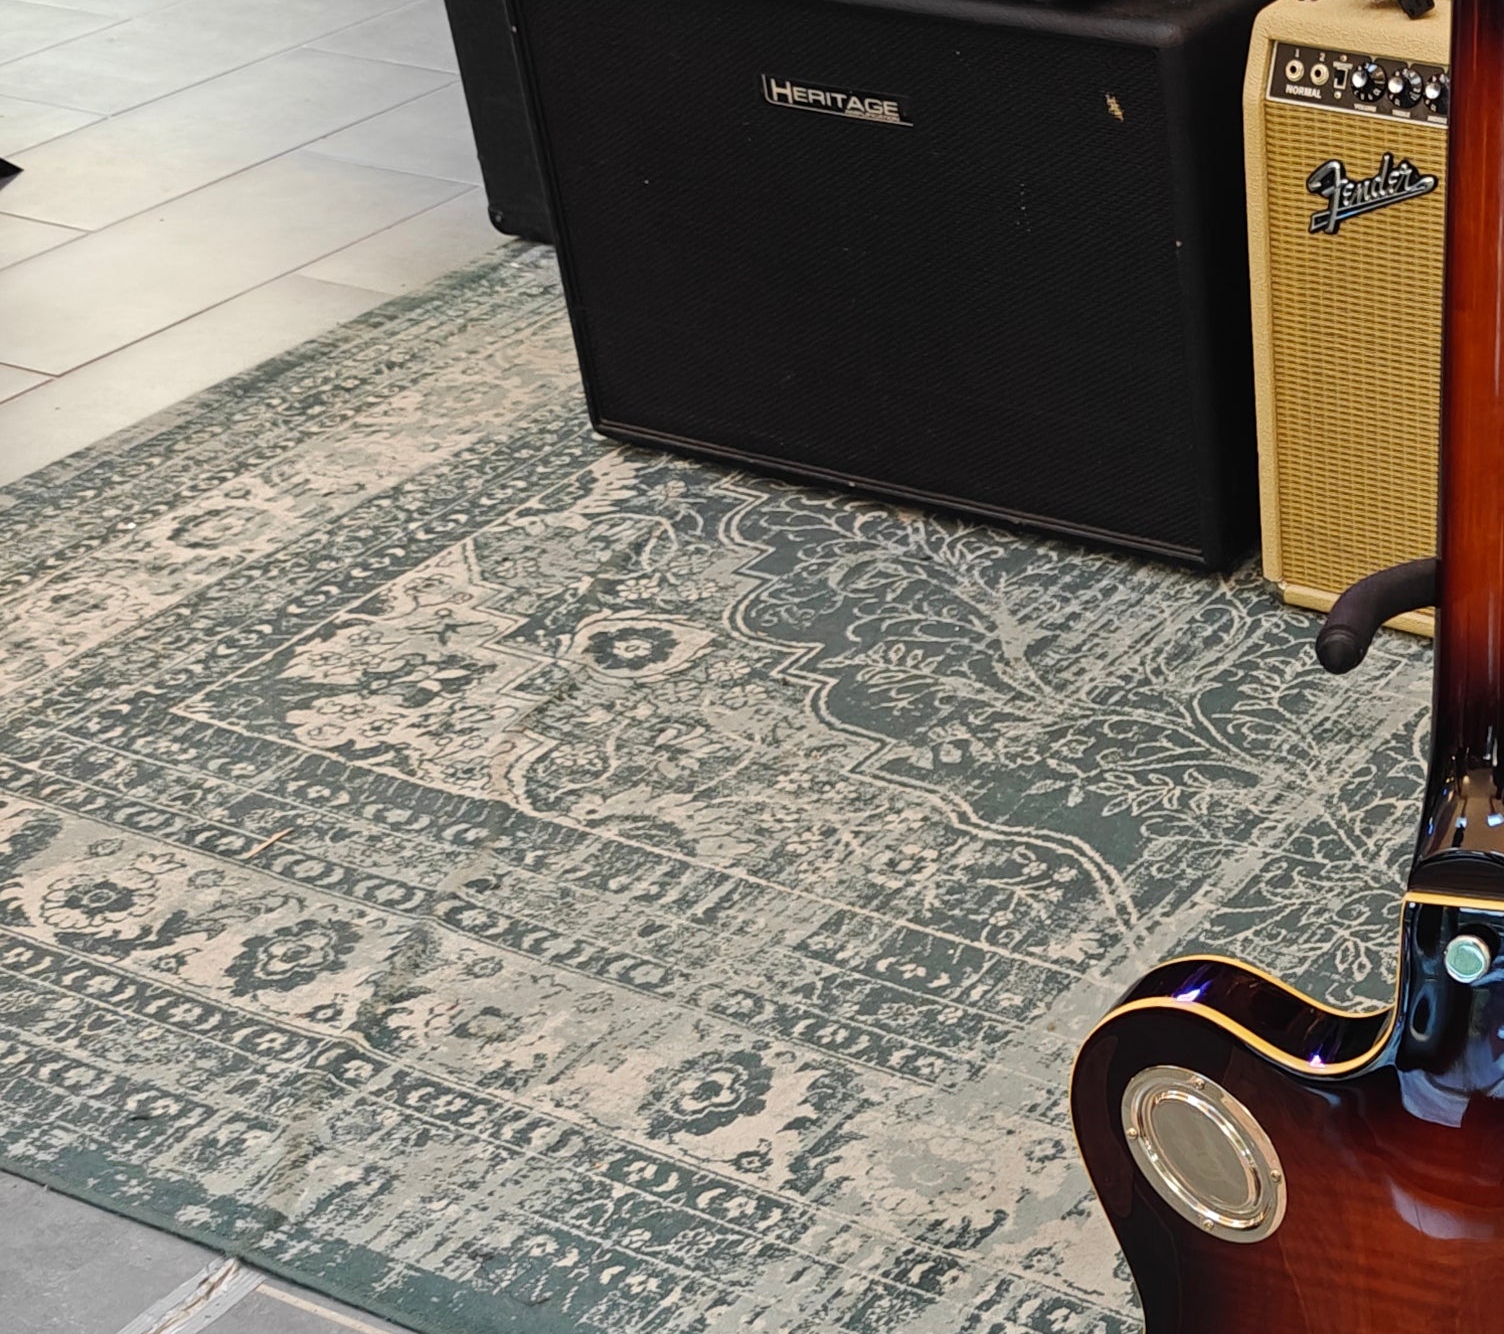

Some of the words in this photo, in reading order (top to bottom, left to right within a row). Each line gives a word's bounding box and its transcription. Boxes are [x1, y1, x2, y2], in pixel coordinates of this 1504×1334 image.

[770, 78, 899, 118] HERITAGE
[1285, 84, 1322, 99] NORMAL
[1306, 152, 1439, 234] Fender
